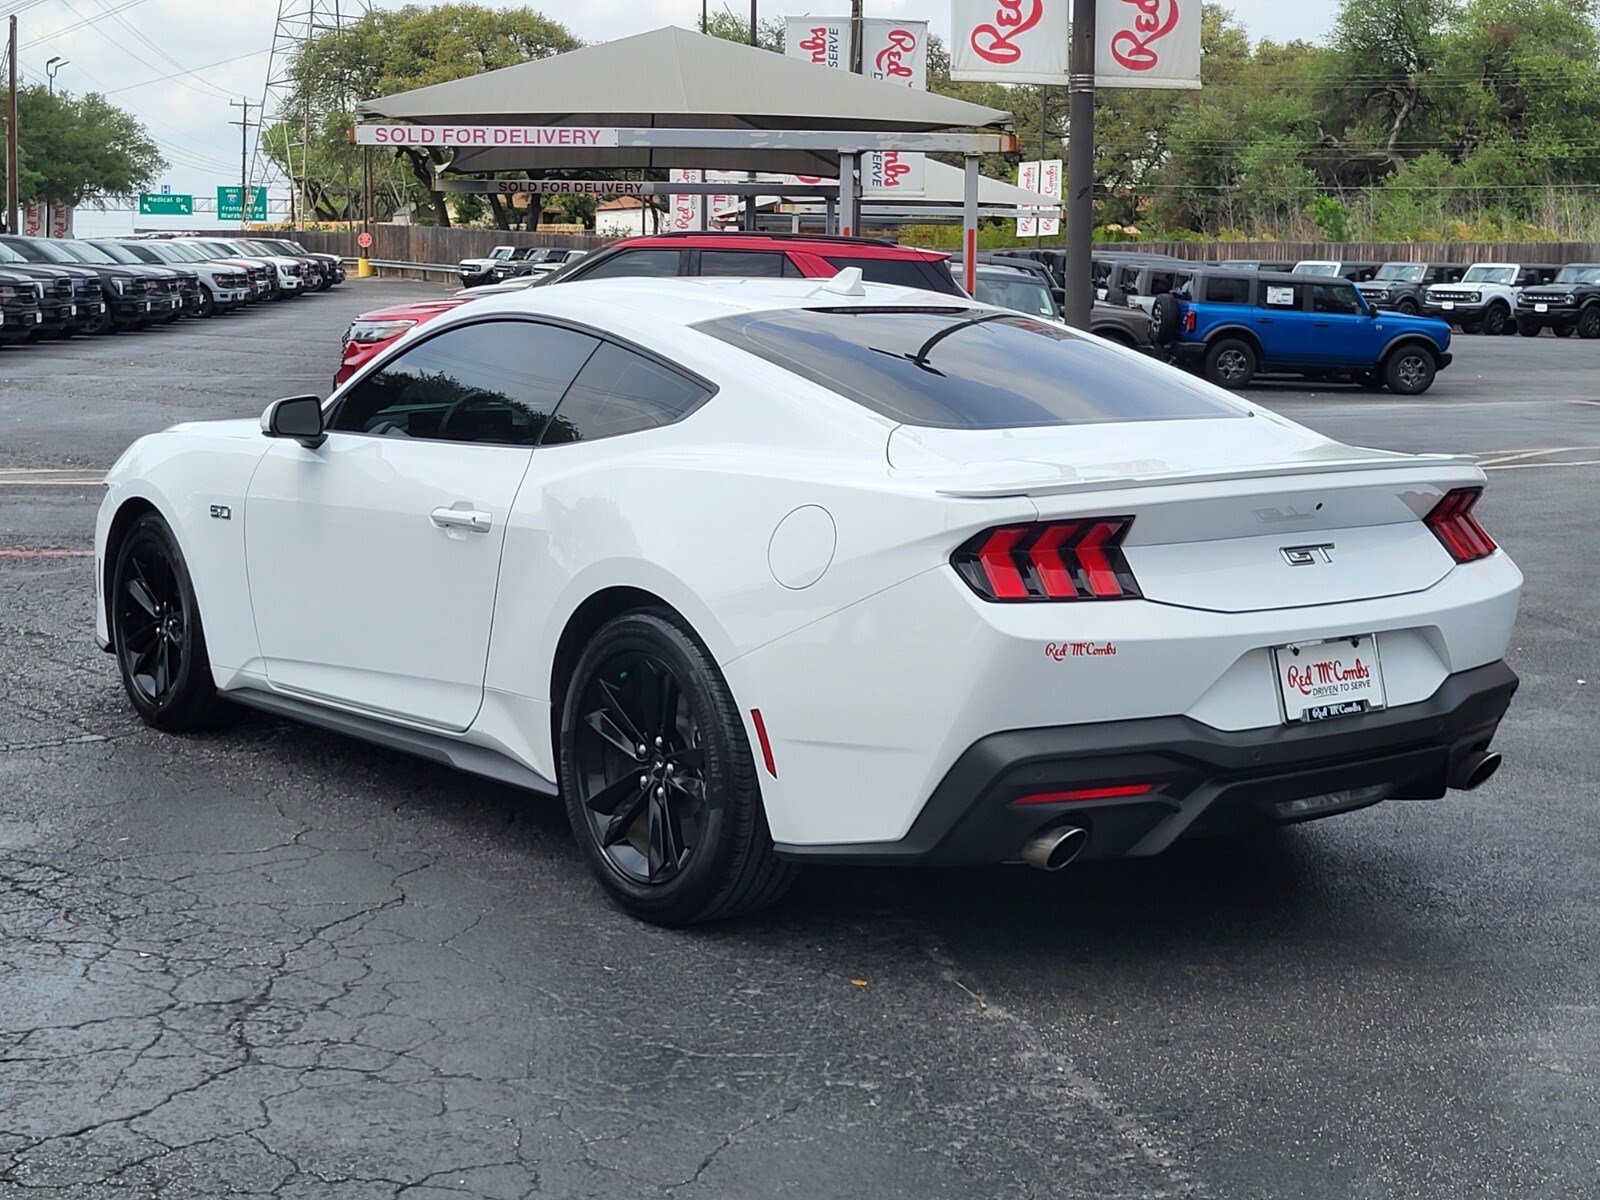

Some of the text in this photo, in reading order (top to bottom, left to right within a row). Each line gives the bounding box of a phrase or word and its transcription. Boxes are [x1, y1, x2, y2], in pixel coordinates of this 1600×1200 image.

[828, 27, 839, 68] SERVE
[875, 29, 916, 77] Red
[375, 127, 602, 146] SOLD FOR DELIVERY
[498, 181, 644, 195] SOLD FOR DELIVERY
[675, 206, 694, 230] Red
[1279, 542, 1335, 567] GT
[1045, 642, 1117, 661] Red McCombs
[1287, 658, 1370, 695] Red McCombs
[1312, 680, 1371, 697] DRIVEN TO SERVE
[1312, 707, 1328, 719] Red
